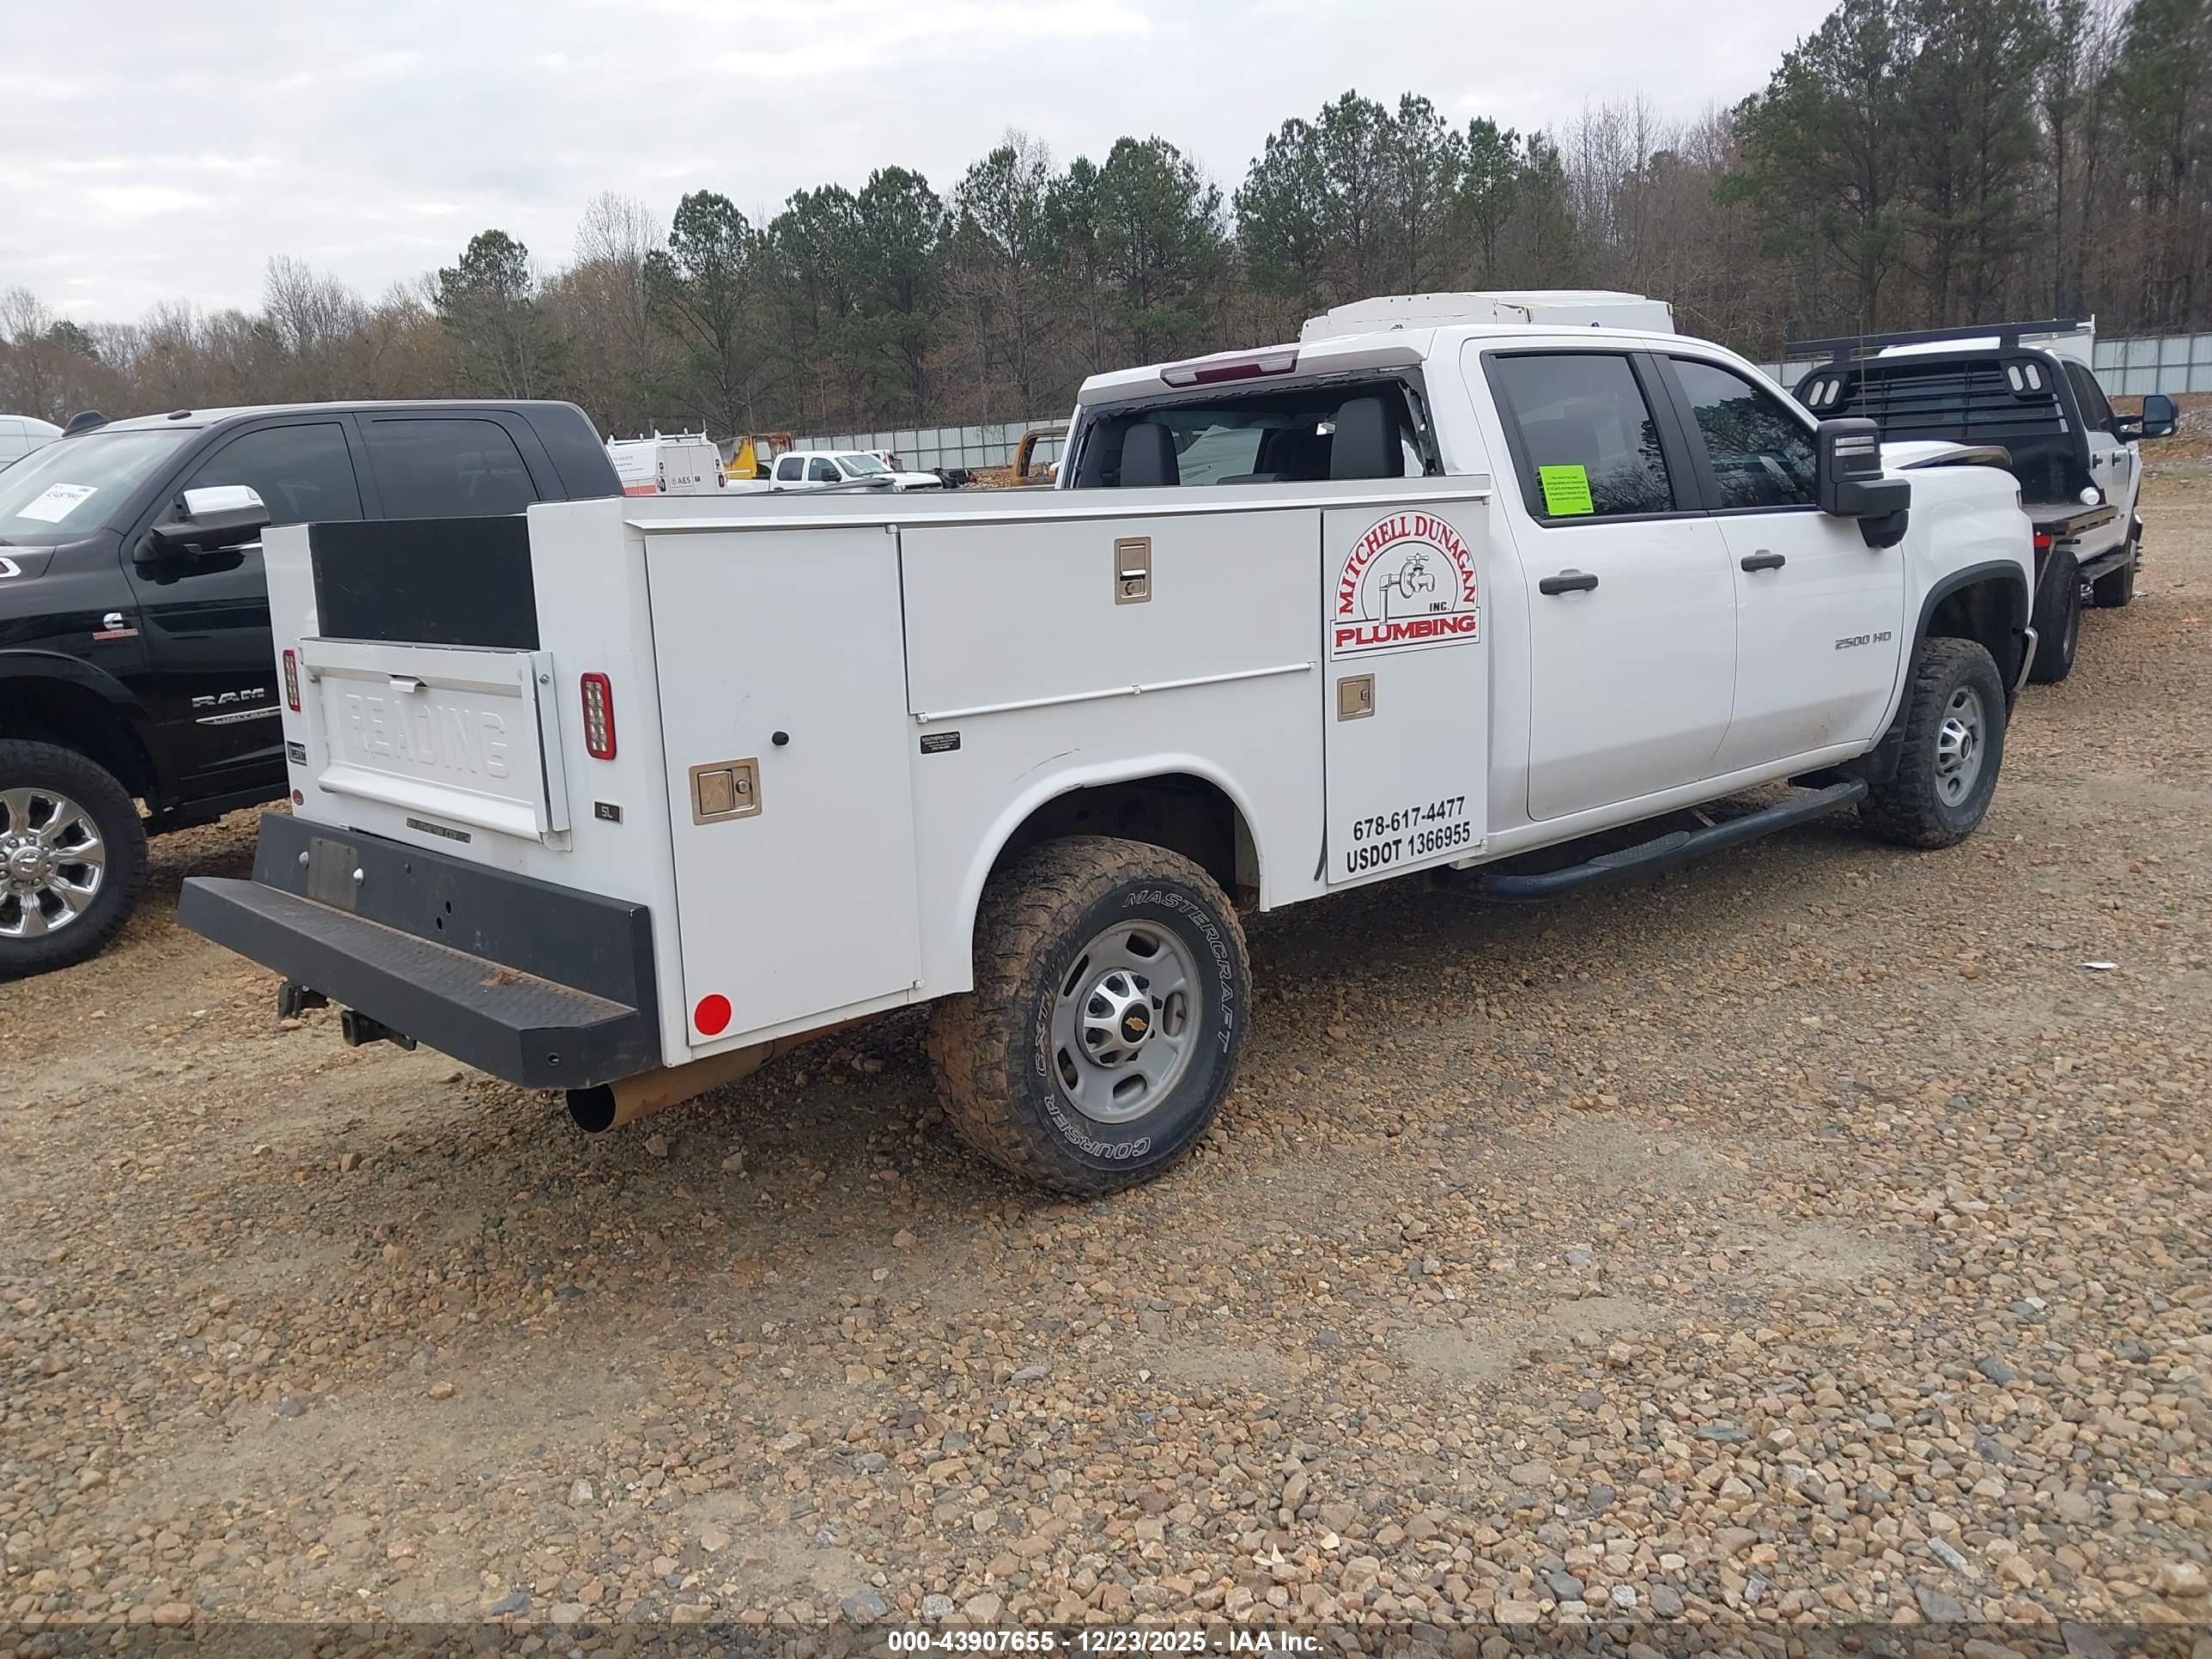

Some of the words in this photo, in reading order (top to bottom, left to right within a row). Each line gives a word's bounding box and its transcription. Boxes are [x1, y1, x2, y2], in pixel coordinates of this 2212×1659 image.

[1339, 516, 1411, 615] MITCHELL
[1413, 515, 1476, 605] DUNAGAN
[1429, 601, 1450, 612] INC.
[1335, 615, 1476, 647] PLUMBING
[1835, 635, 1870, 650] 2500
[1873, 630, 1892, 643] HD
[191, 688, 264, 708] RAM
[344, 693, 510, 780] READING
[601, 805, 613, 818] SL
[1353, 796, 1465, 841] 678-617-4477
[1347, 838, 1402, 873] USDOT
[1408, 821, 1471, 856] 1366955
[1121, 889, 1234, 1054] MASTERCRAFT
[1035, 994, 1048, 1077] CXT
[1044, 1094, 1152, 1160] COURSER
